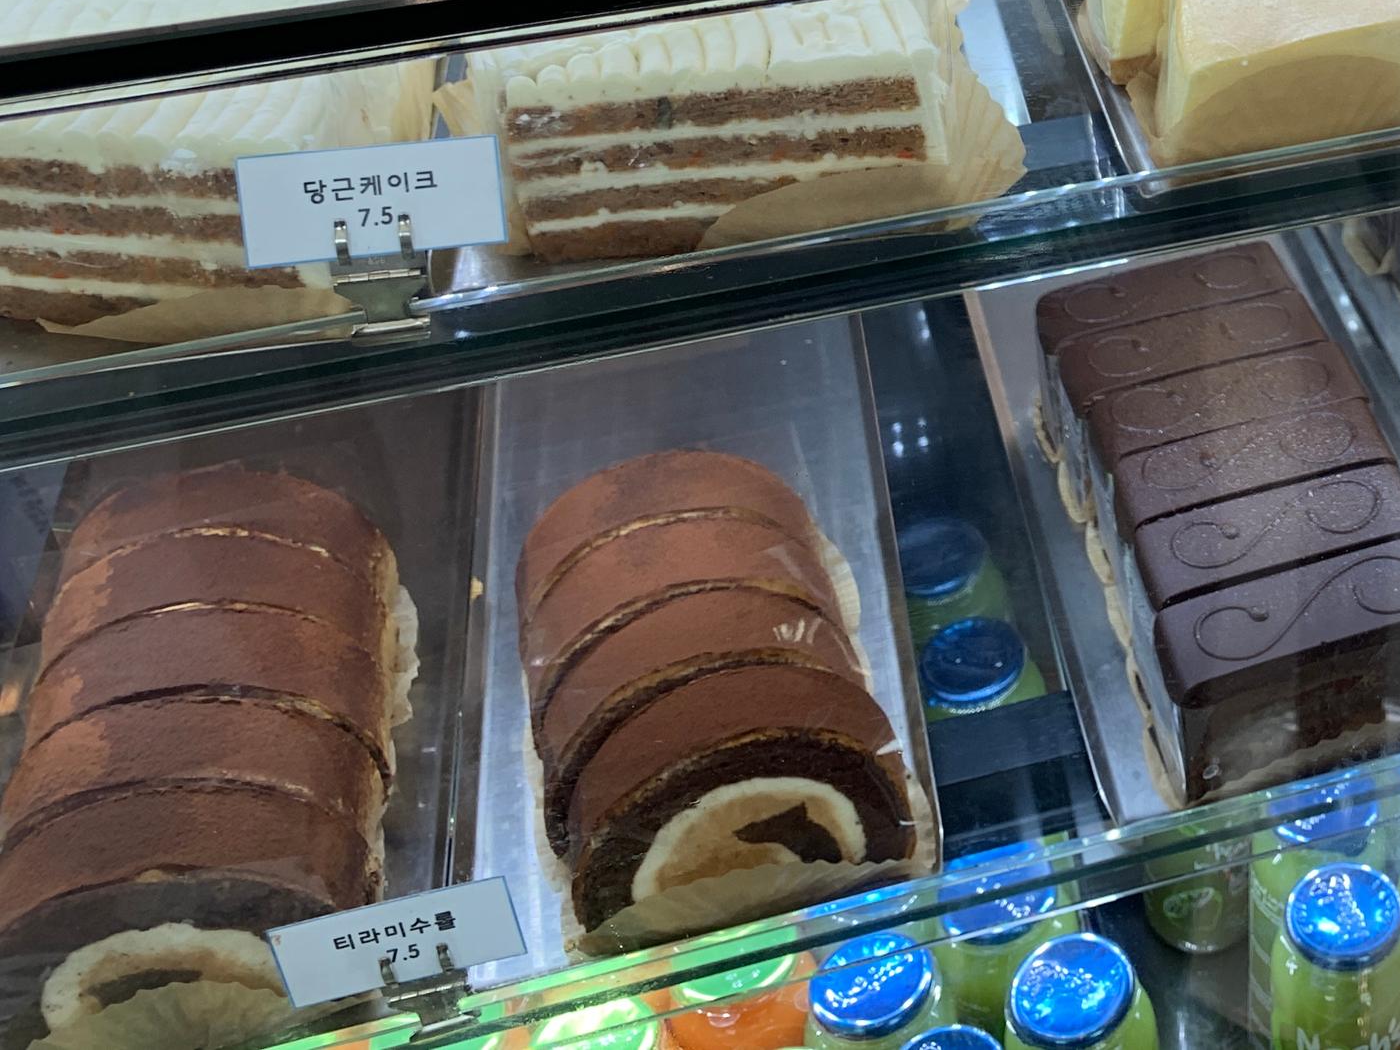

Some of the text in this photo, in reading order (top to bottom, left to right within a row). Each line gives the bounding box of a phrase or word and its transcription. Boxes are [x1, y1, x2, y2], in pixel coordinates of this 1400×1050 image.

[303, 170, 438, 205] 당근케이크
[357, 206, 394, 228] 7.5
[333, 910, 457, 951] 티라미수롤
[386, 943, 421, 963] 7.5
